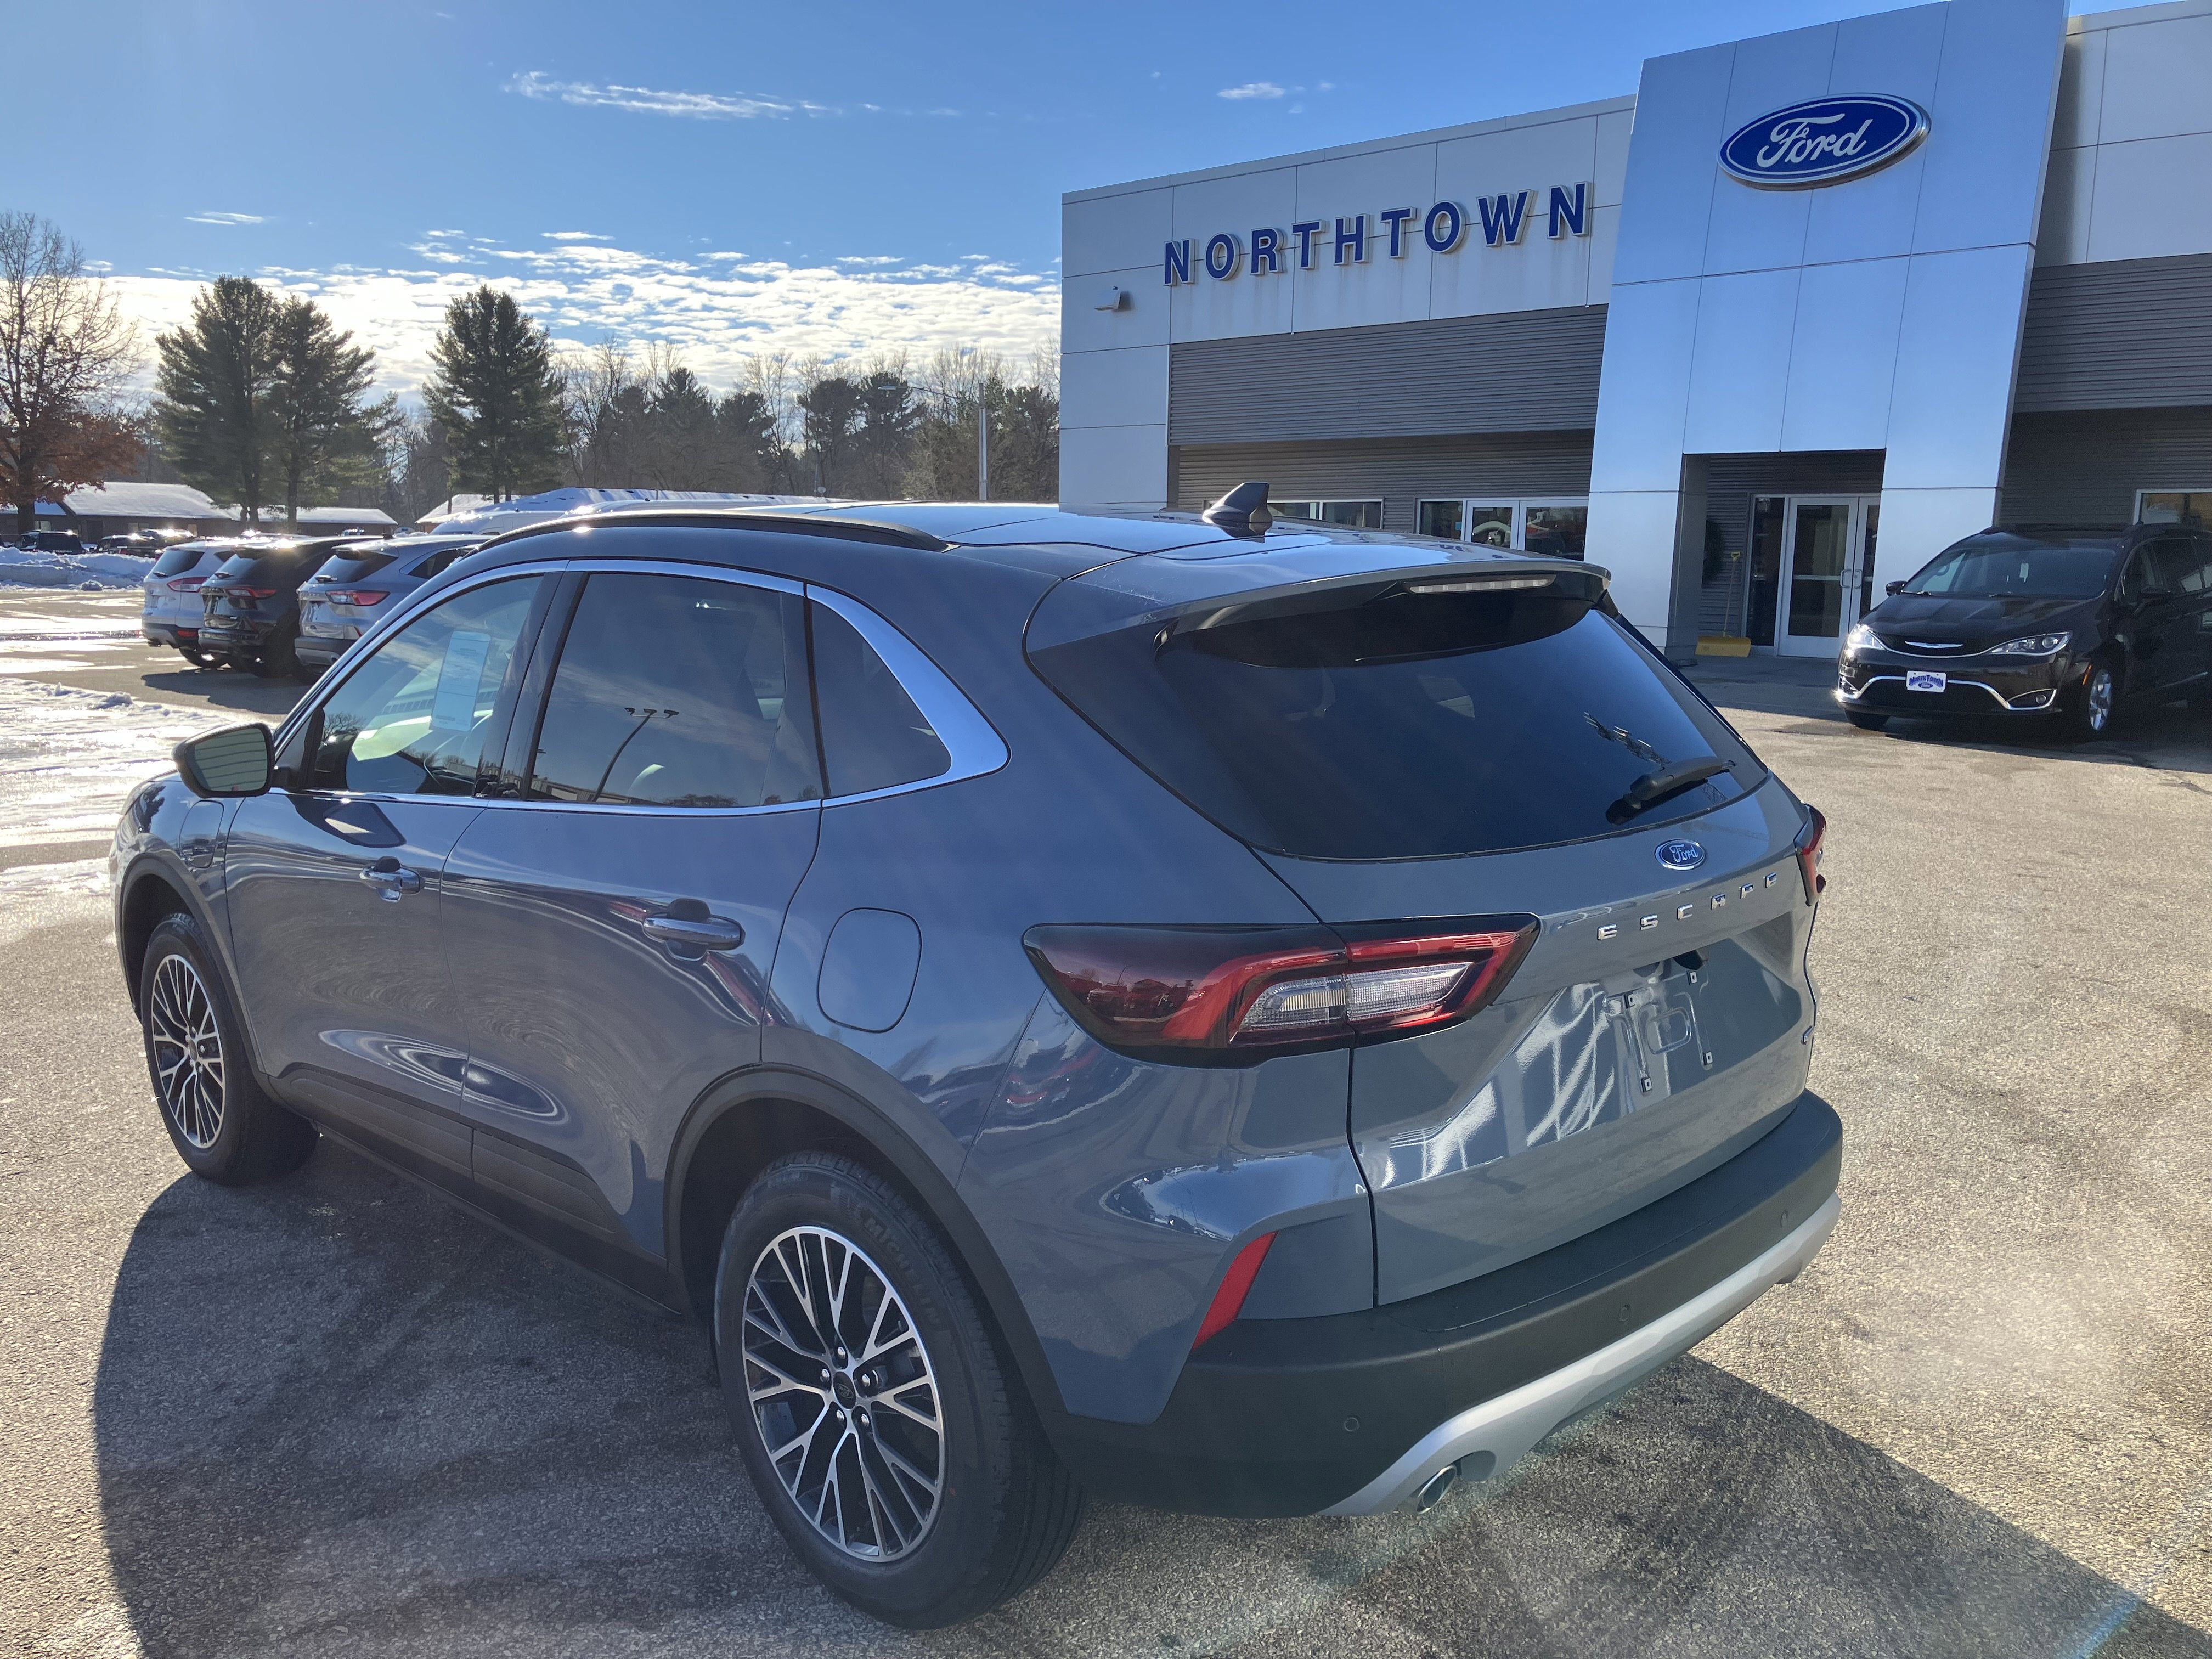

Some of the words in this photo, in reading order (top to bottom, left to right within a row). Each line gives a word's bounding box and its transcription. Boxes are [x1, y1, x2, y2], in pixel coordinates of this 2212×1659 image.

[1757, 113, 1873, 167] Ford
[1163, 181, 1591, 286] NORTHTOWN
[1669, 843, 1699, 863] Ford
[1597, 872, 1778, 940] ESCAPE
